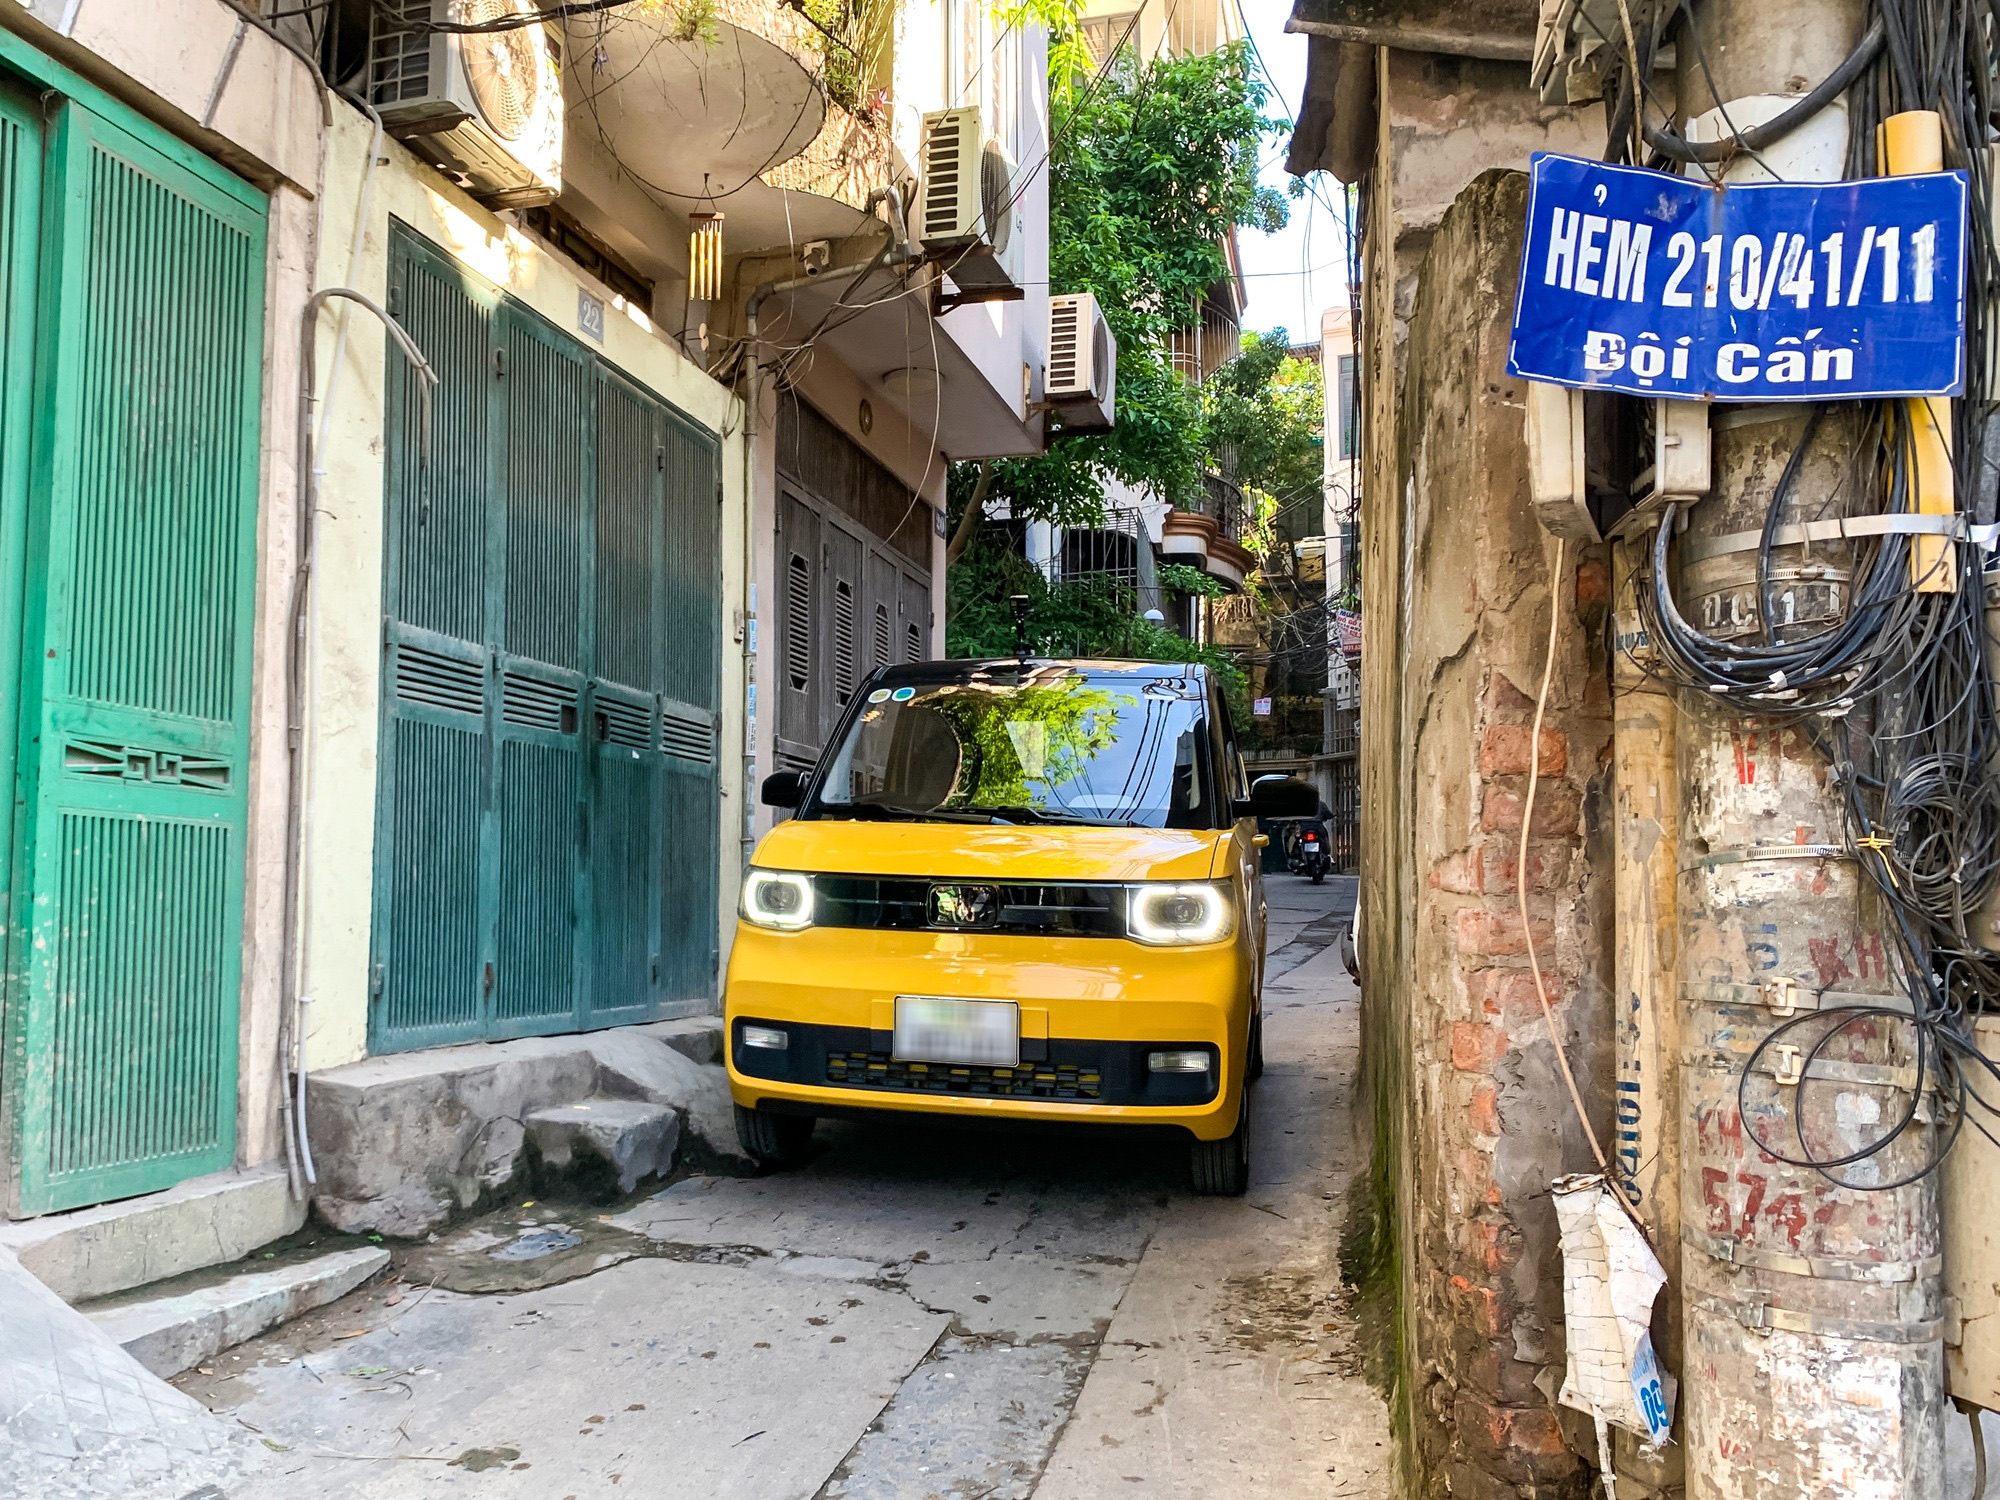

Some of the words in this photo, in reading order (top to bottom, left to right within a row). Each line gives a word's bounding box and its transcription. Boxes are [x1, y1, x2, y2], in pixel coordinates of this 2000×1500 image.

[1544, 183, 1653, 303] HẺM
[1661, 222, 1938, 312] 210/41/11
[583, 300, 599, 333] 22
[1716, 327, 1855, 384] Cấn
